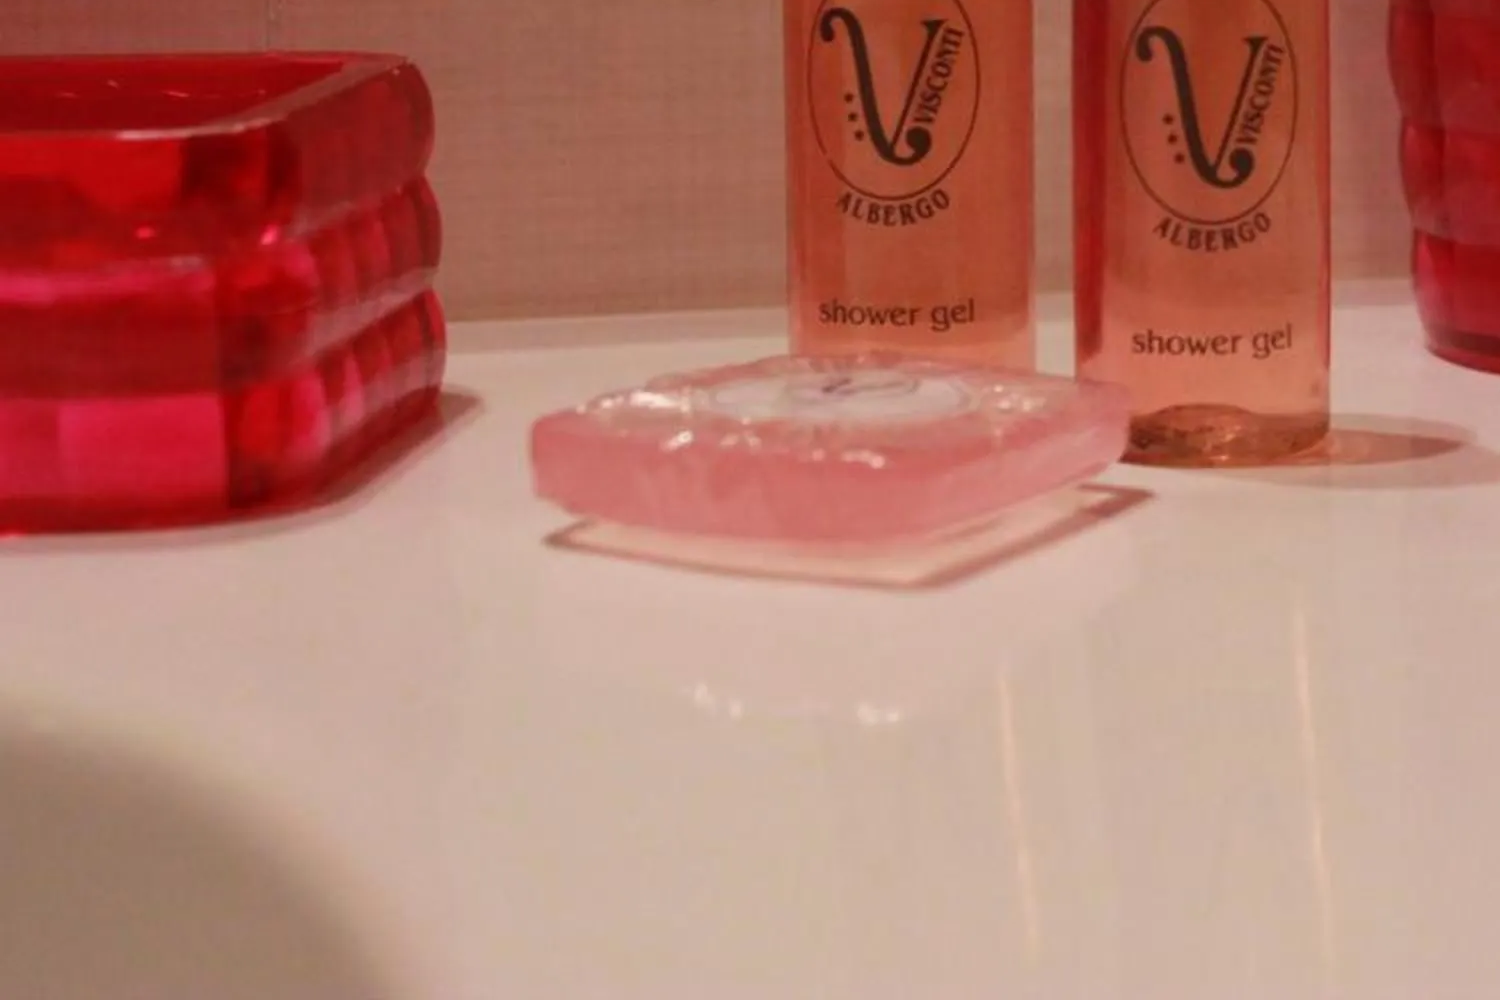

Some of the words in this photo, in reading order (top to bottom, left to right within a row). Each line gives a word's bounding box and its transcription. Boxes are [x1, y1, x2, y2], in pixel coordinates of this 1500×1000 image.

[820, 7, 948, 166] V
[914, 26, 966, 125] VISCONTI
[1136, 25, 1269, 189] V
[1236, 44, 1286, 146] VISCONTI
[836, 188, 951, 227] ALBERGO
[1153, 212, 1272, 253] ALBERGO
[818, 299, 922, 327] shower
[930, 299, 975, 331] gel
[1131, 329, 1243, 357] shower
[1251, 324, 1293, 359] gel
